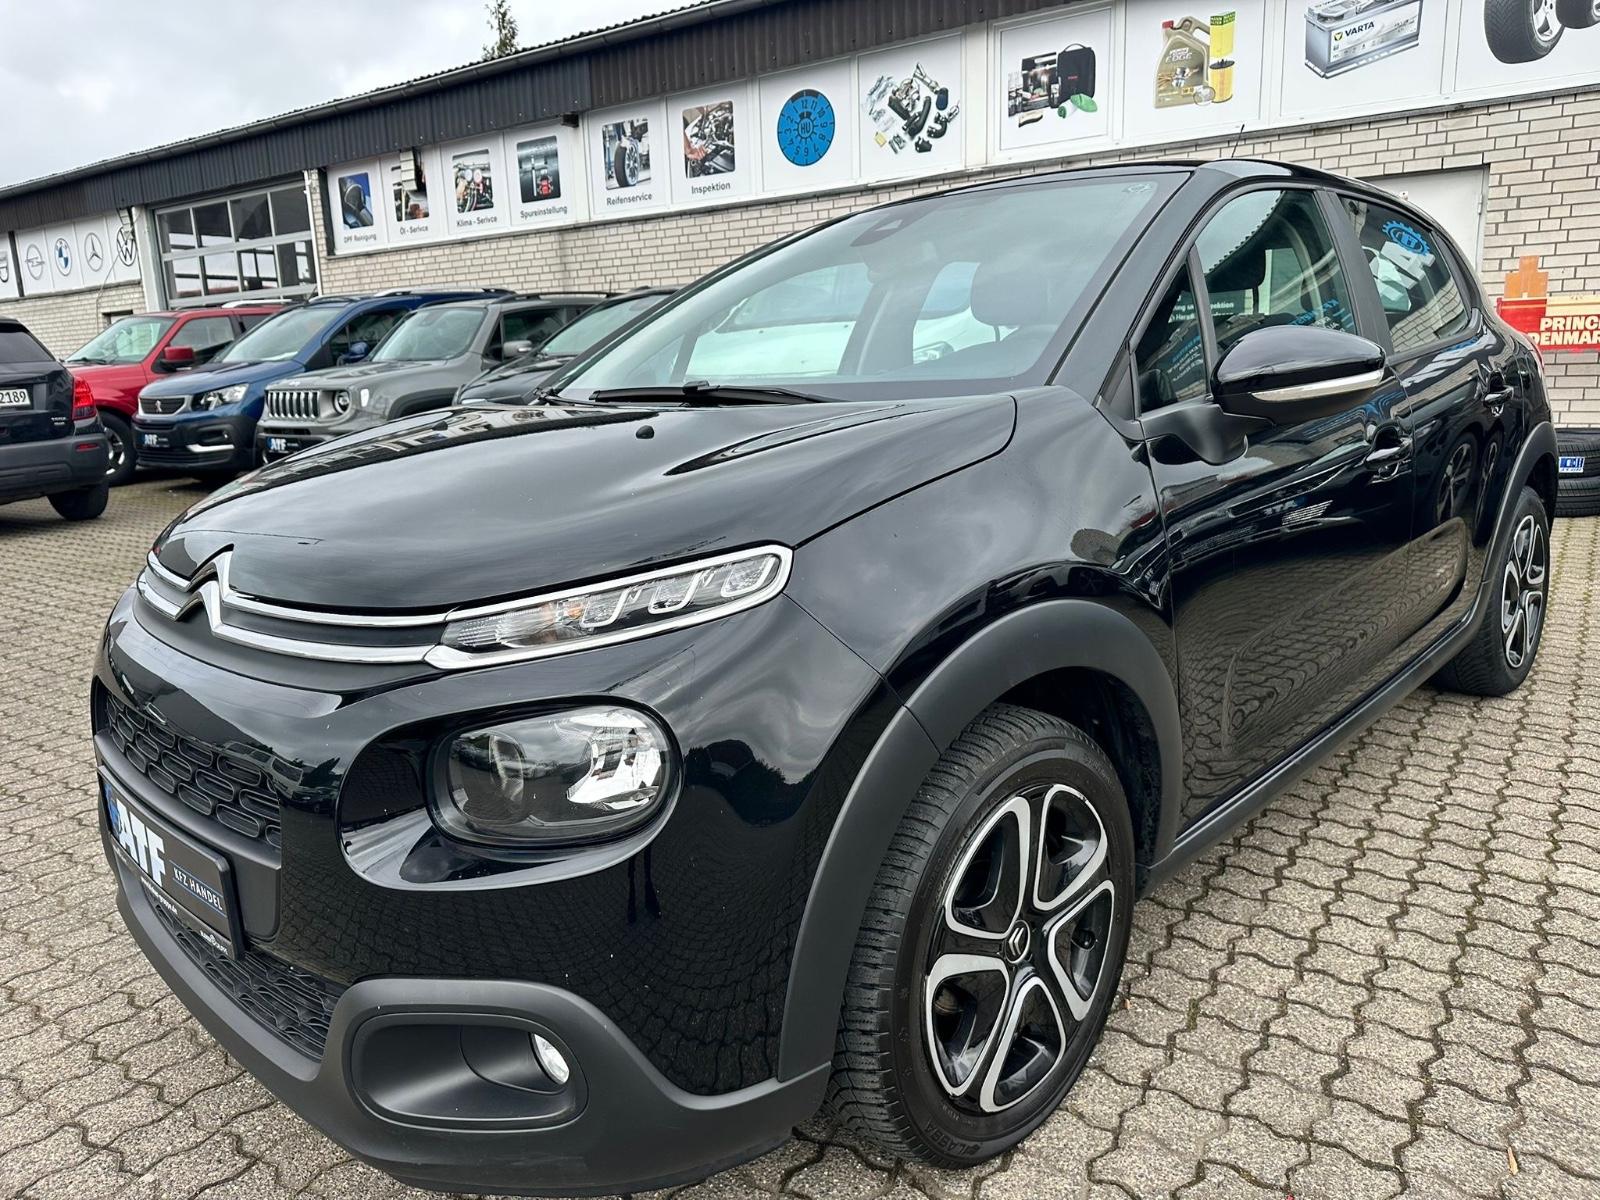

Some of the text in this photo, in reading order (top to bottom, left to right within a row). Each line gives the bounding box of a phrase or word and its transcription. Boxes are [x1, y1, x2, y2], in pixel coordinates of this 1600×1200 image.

[1344, 21, 1375, 37] VARTA
[800, 120, 811, 134] HU
[691, 182, 731, 195] Inspektion
[606, 192, 653, 206] Reifenservice
[520, 206, 568, 219] Spureinstellung
[457, 218, 472, 227] Klima
[1540, 315, 1600, 331] PRINC
[0, 390, 27, 404] 2189
[116, 798, 166, 888] ATF
[173, 867, 189, 886] KFZ
[189, 878, 223, 911] HANDEL
